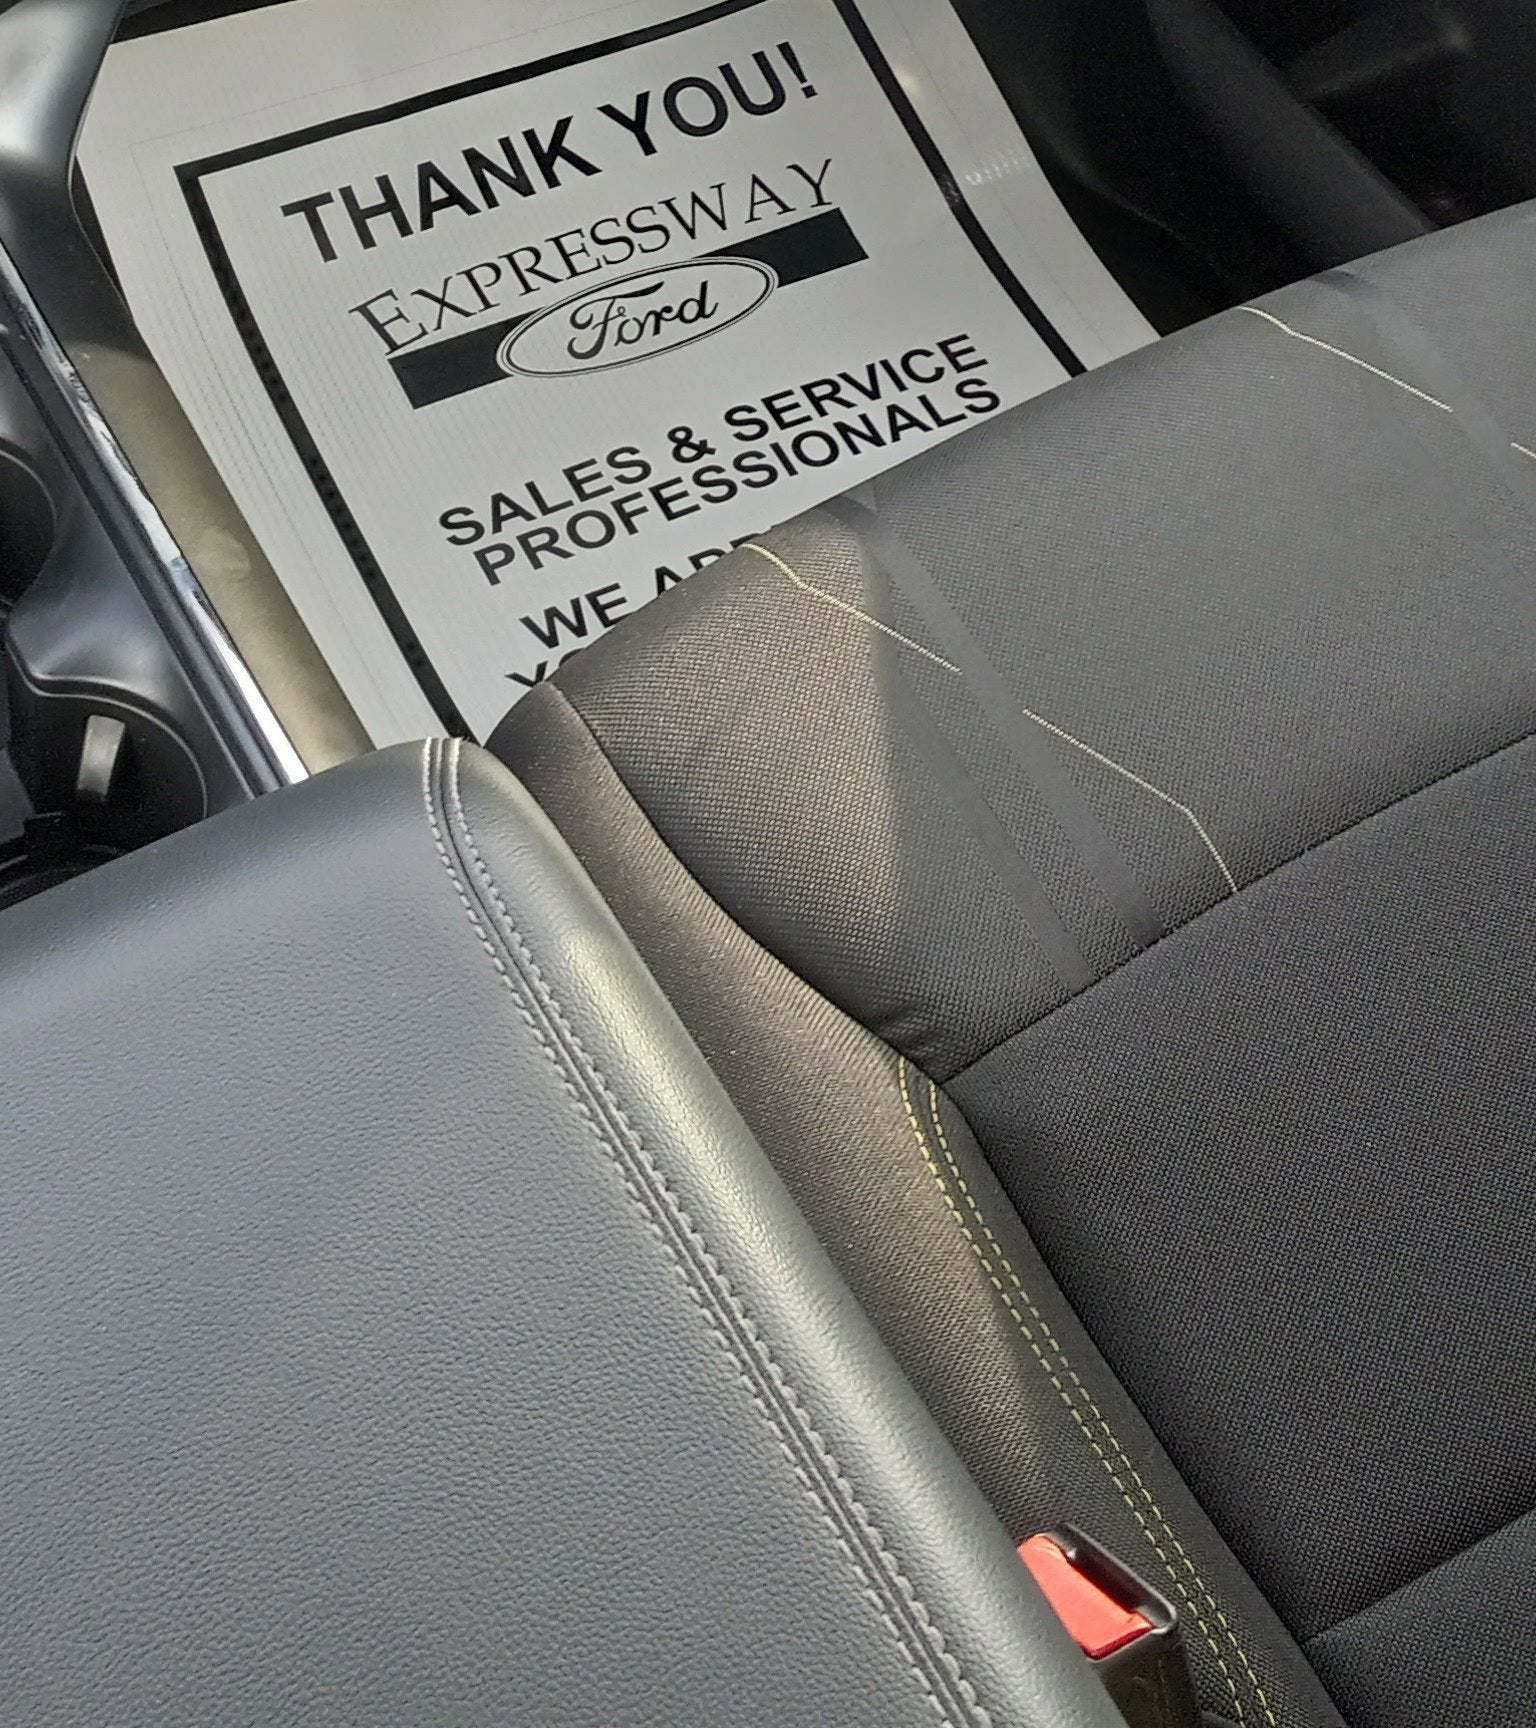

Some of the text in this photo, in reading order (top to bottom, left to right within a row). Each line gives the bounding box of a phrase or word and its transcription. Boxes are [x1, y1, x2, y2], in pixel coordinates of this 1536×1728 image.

[280, 40, 819, 266] THANK YOU!
[565, 276, 719, 363] Ford
[438, 332, 990, 549] SALES & SERVICE
[473, 376, 1002, 587] PROFESSIONALS
[519, 581, 628, 650] WE
